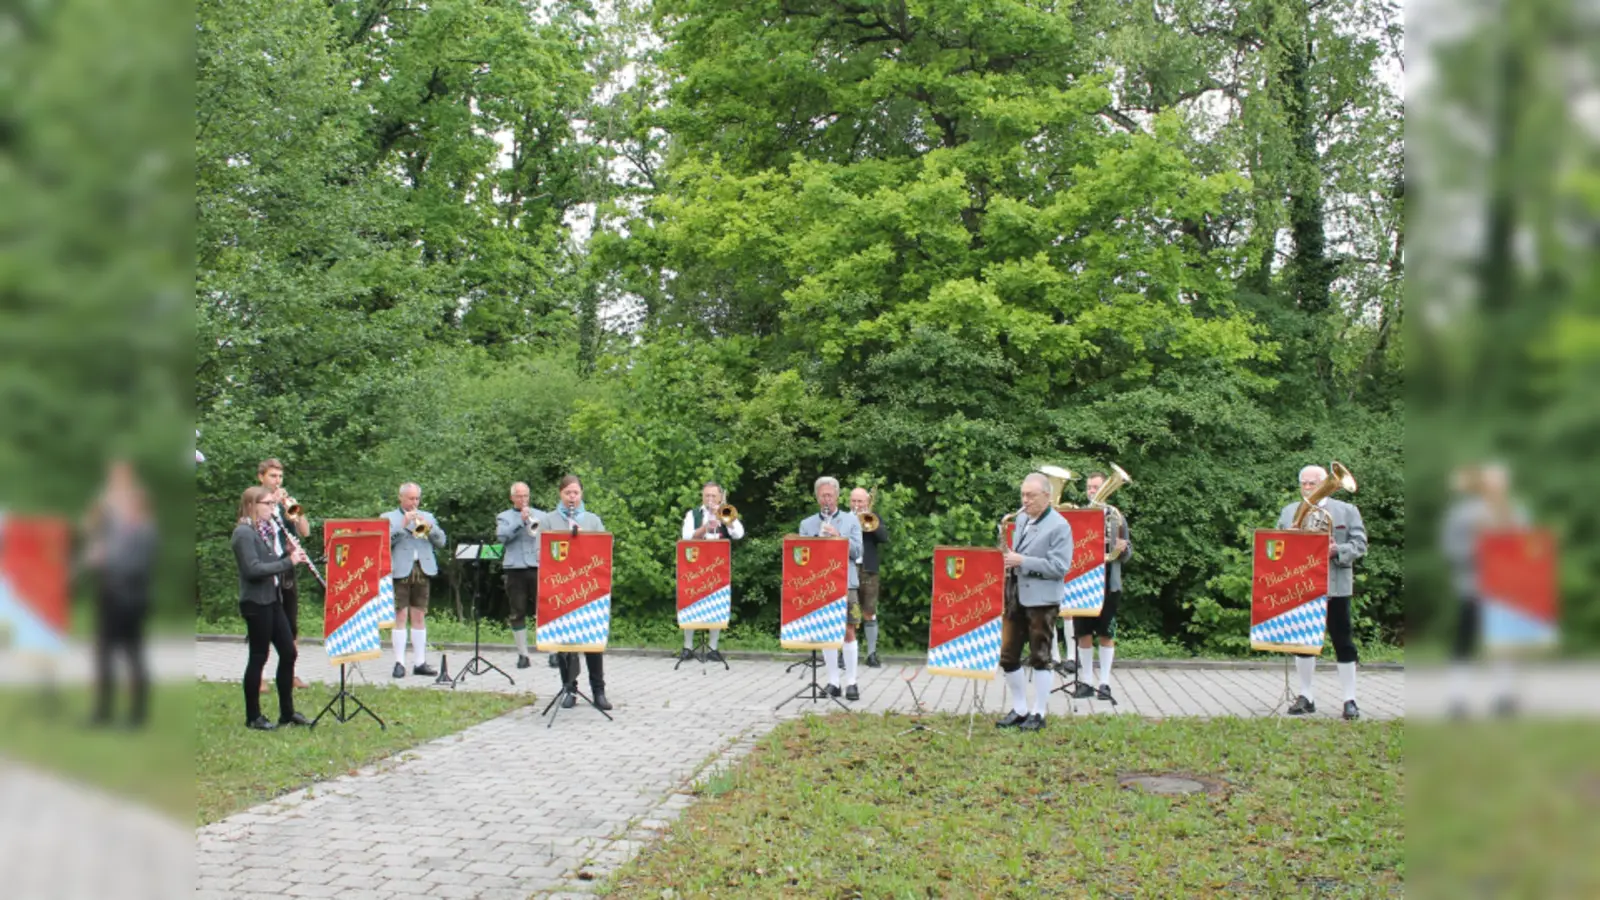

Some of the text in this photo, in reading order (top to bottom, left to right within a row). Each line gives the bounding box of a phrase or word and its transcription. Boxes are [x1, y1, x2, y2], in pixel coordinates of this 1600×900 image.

[1258, 554, 1321, 588] Blaskapelle
[548, 578, 599, 610] Karlsfeld
[1262, 578, 1316, 611] Karlsfeld
[941, 597, 992, 631] Karlsfeld
